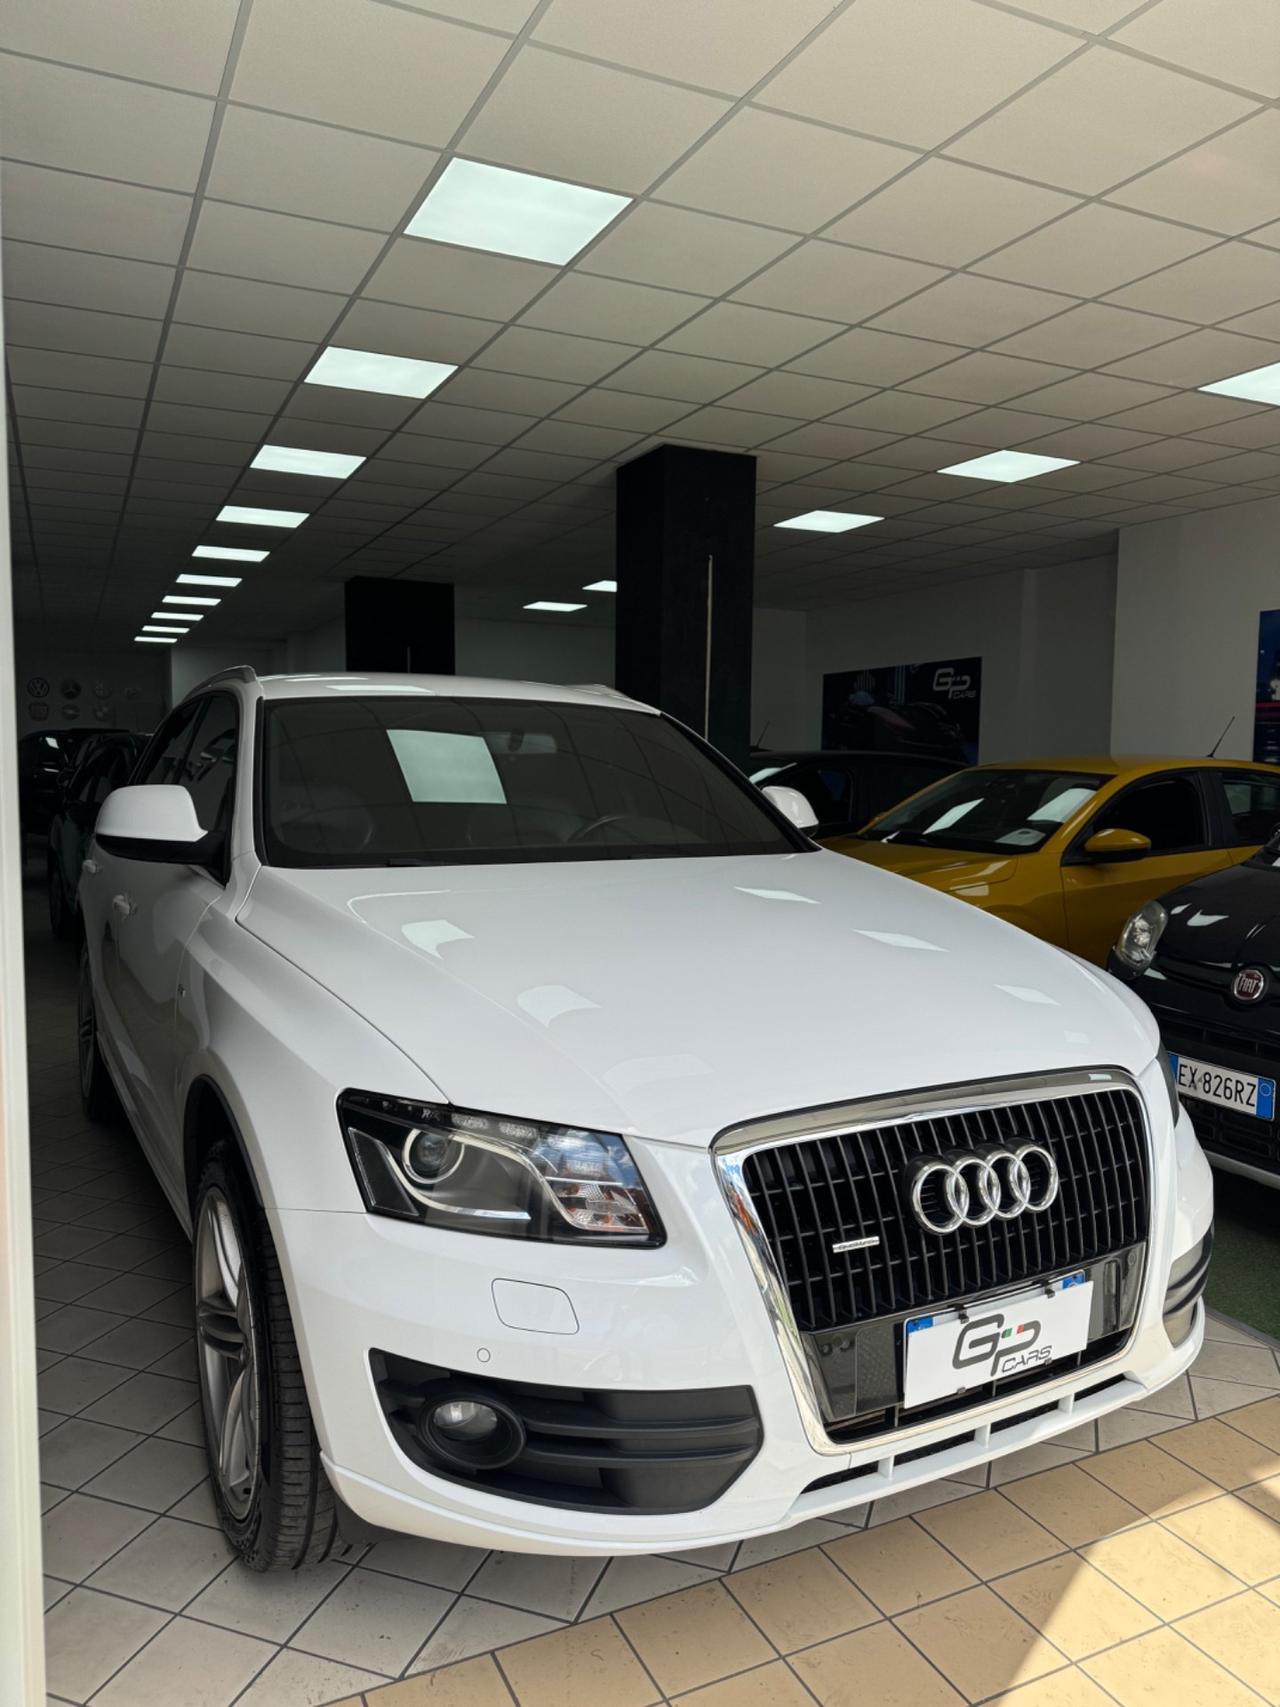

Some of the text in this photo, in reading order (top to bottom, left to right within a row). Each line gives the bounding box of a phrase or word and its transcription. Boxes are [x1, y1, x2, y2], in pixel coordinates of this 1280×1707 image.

[933, 667, 971, 699] GP
[952, 1313, 1042, 1377] GP
[1001, 1345, 1053, 1373] CARS
